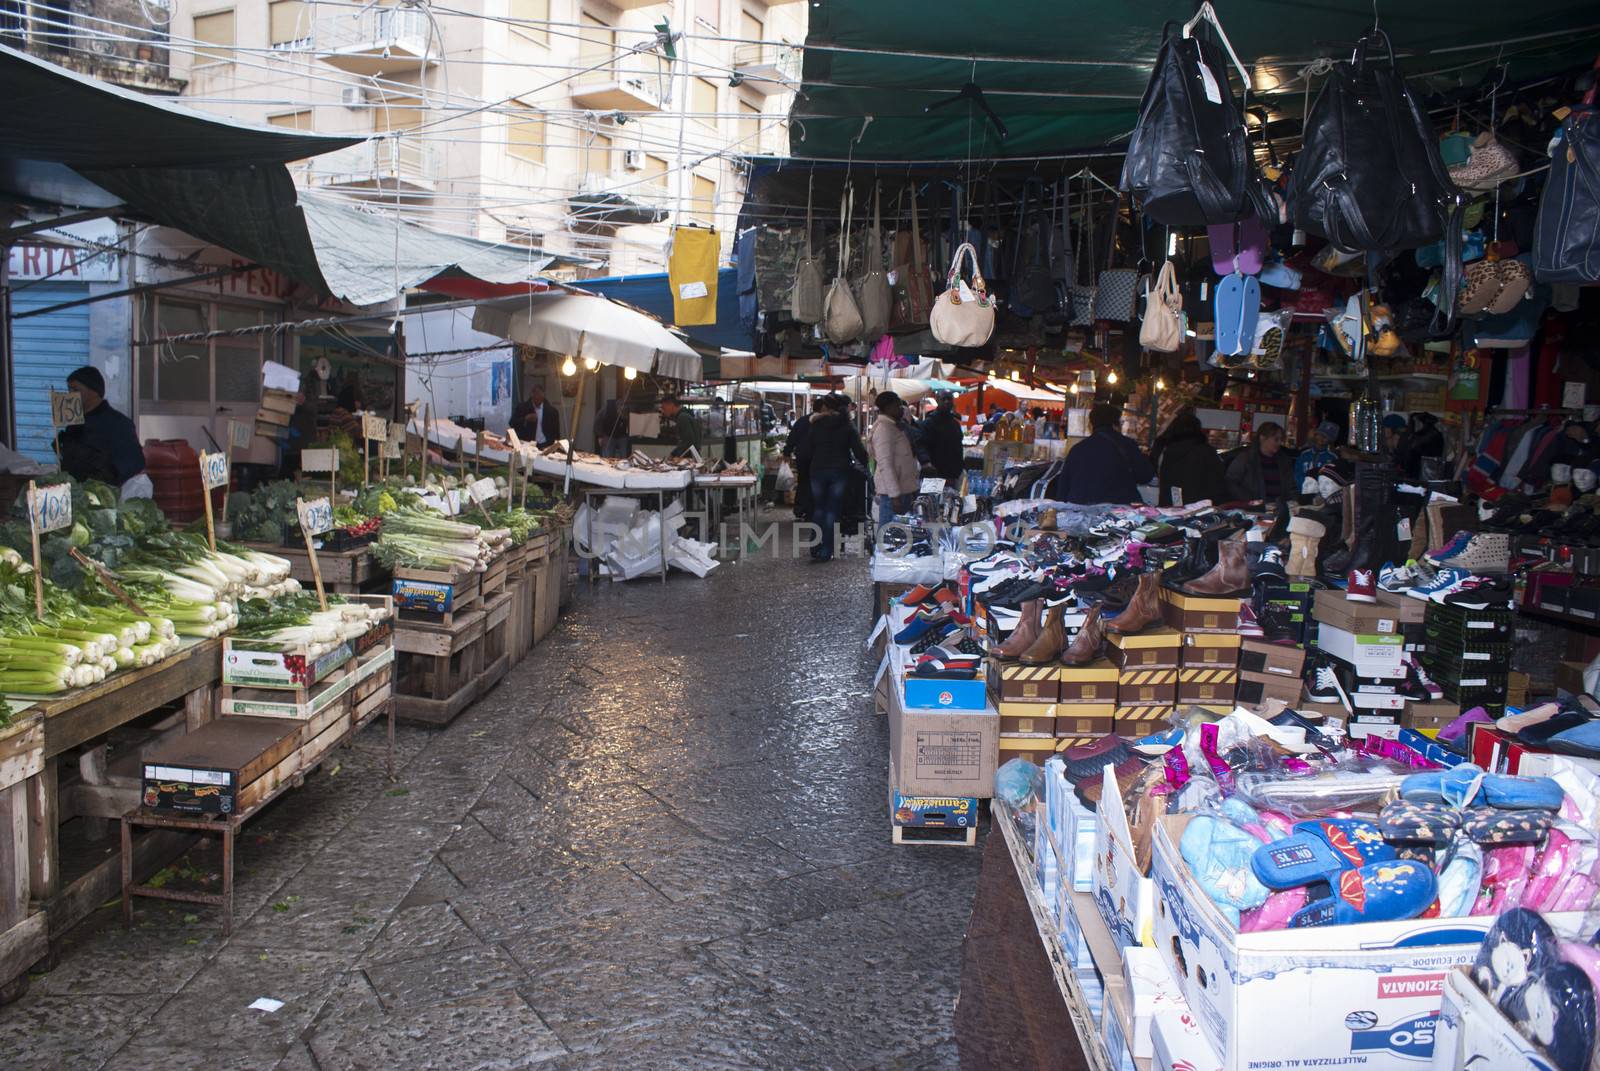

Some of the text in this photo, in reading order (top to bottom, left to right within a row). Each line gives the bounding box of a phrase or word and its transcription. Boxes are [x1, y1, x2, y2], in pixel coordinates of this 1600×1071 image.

[1412, 956, 1452, 966] ECUADOR
[1247, 1060, 1282, 1069] ORIGINE
[1303, 1056, 1368, 1067] PALLETTIZZATA
